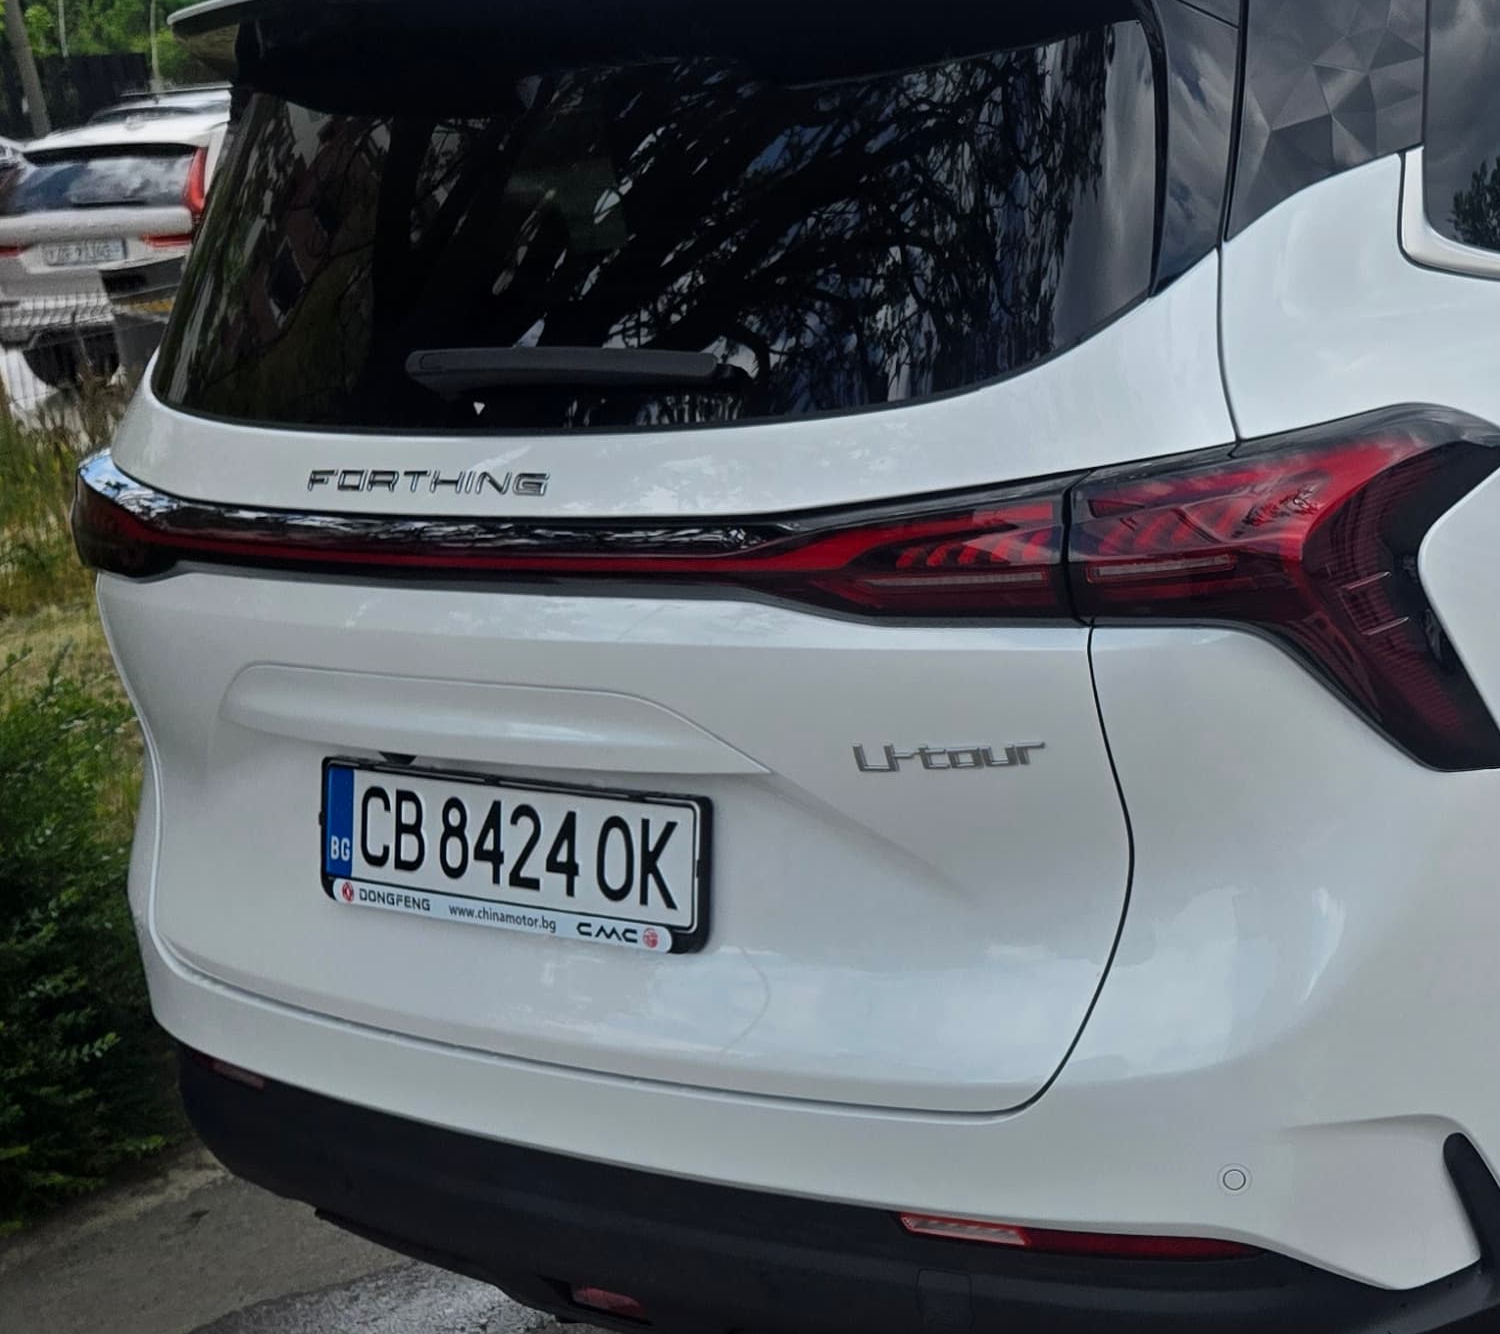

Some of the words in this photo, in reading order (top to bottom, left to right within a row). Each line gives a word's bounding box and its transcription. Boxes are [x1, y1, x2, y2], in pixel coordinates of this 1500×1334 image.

[307, 469, 551, 496] FORTHING
[852, 741, 1046, 772] U-tour
[330, 834, 351, 861] BG
[360, 785, 426, 872] CB
[439, 796, 580, 898] 8424
[597, 815, 679, 911] OK
[358, 888, 431, 913] DONGFENG
[448, 903, 557, 934] www.chinamotor.bg
[576, 922, 638, 944] CMC
